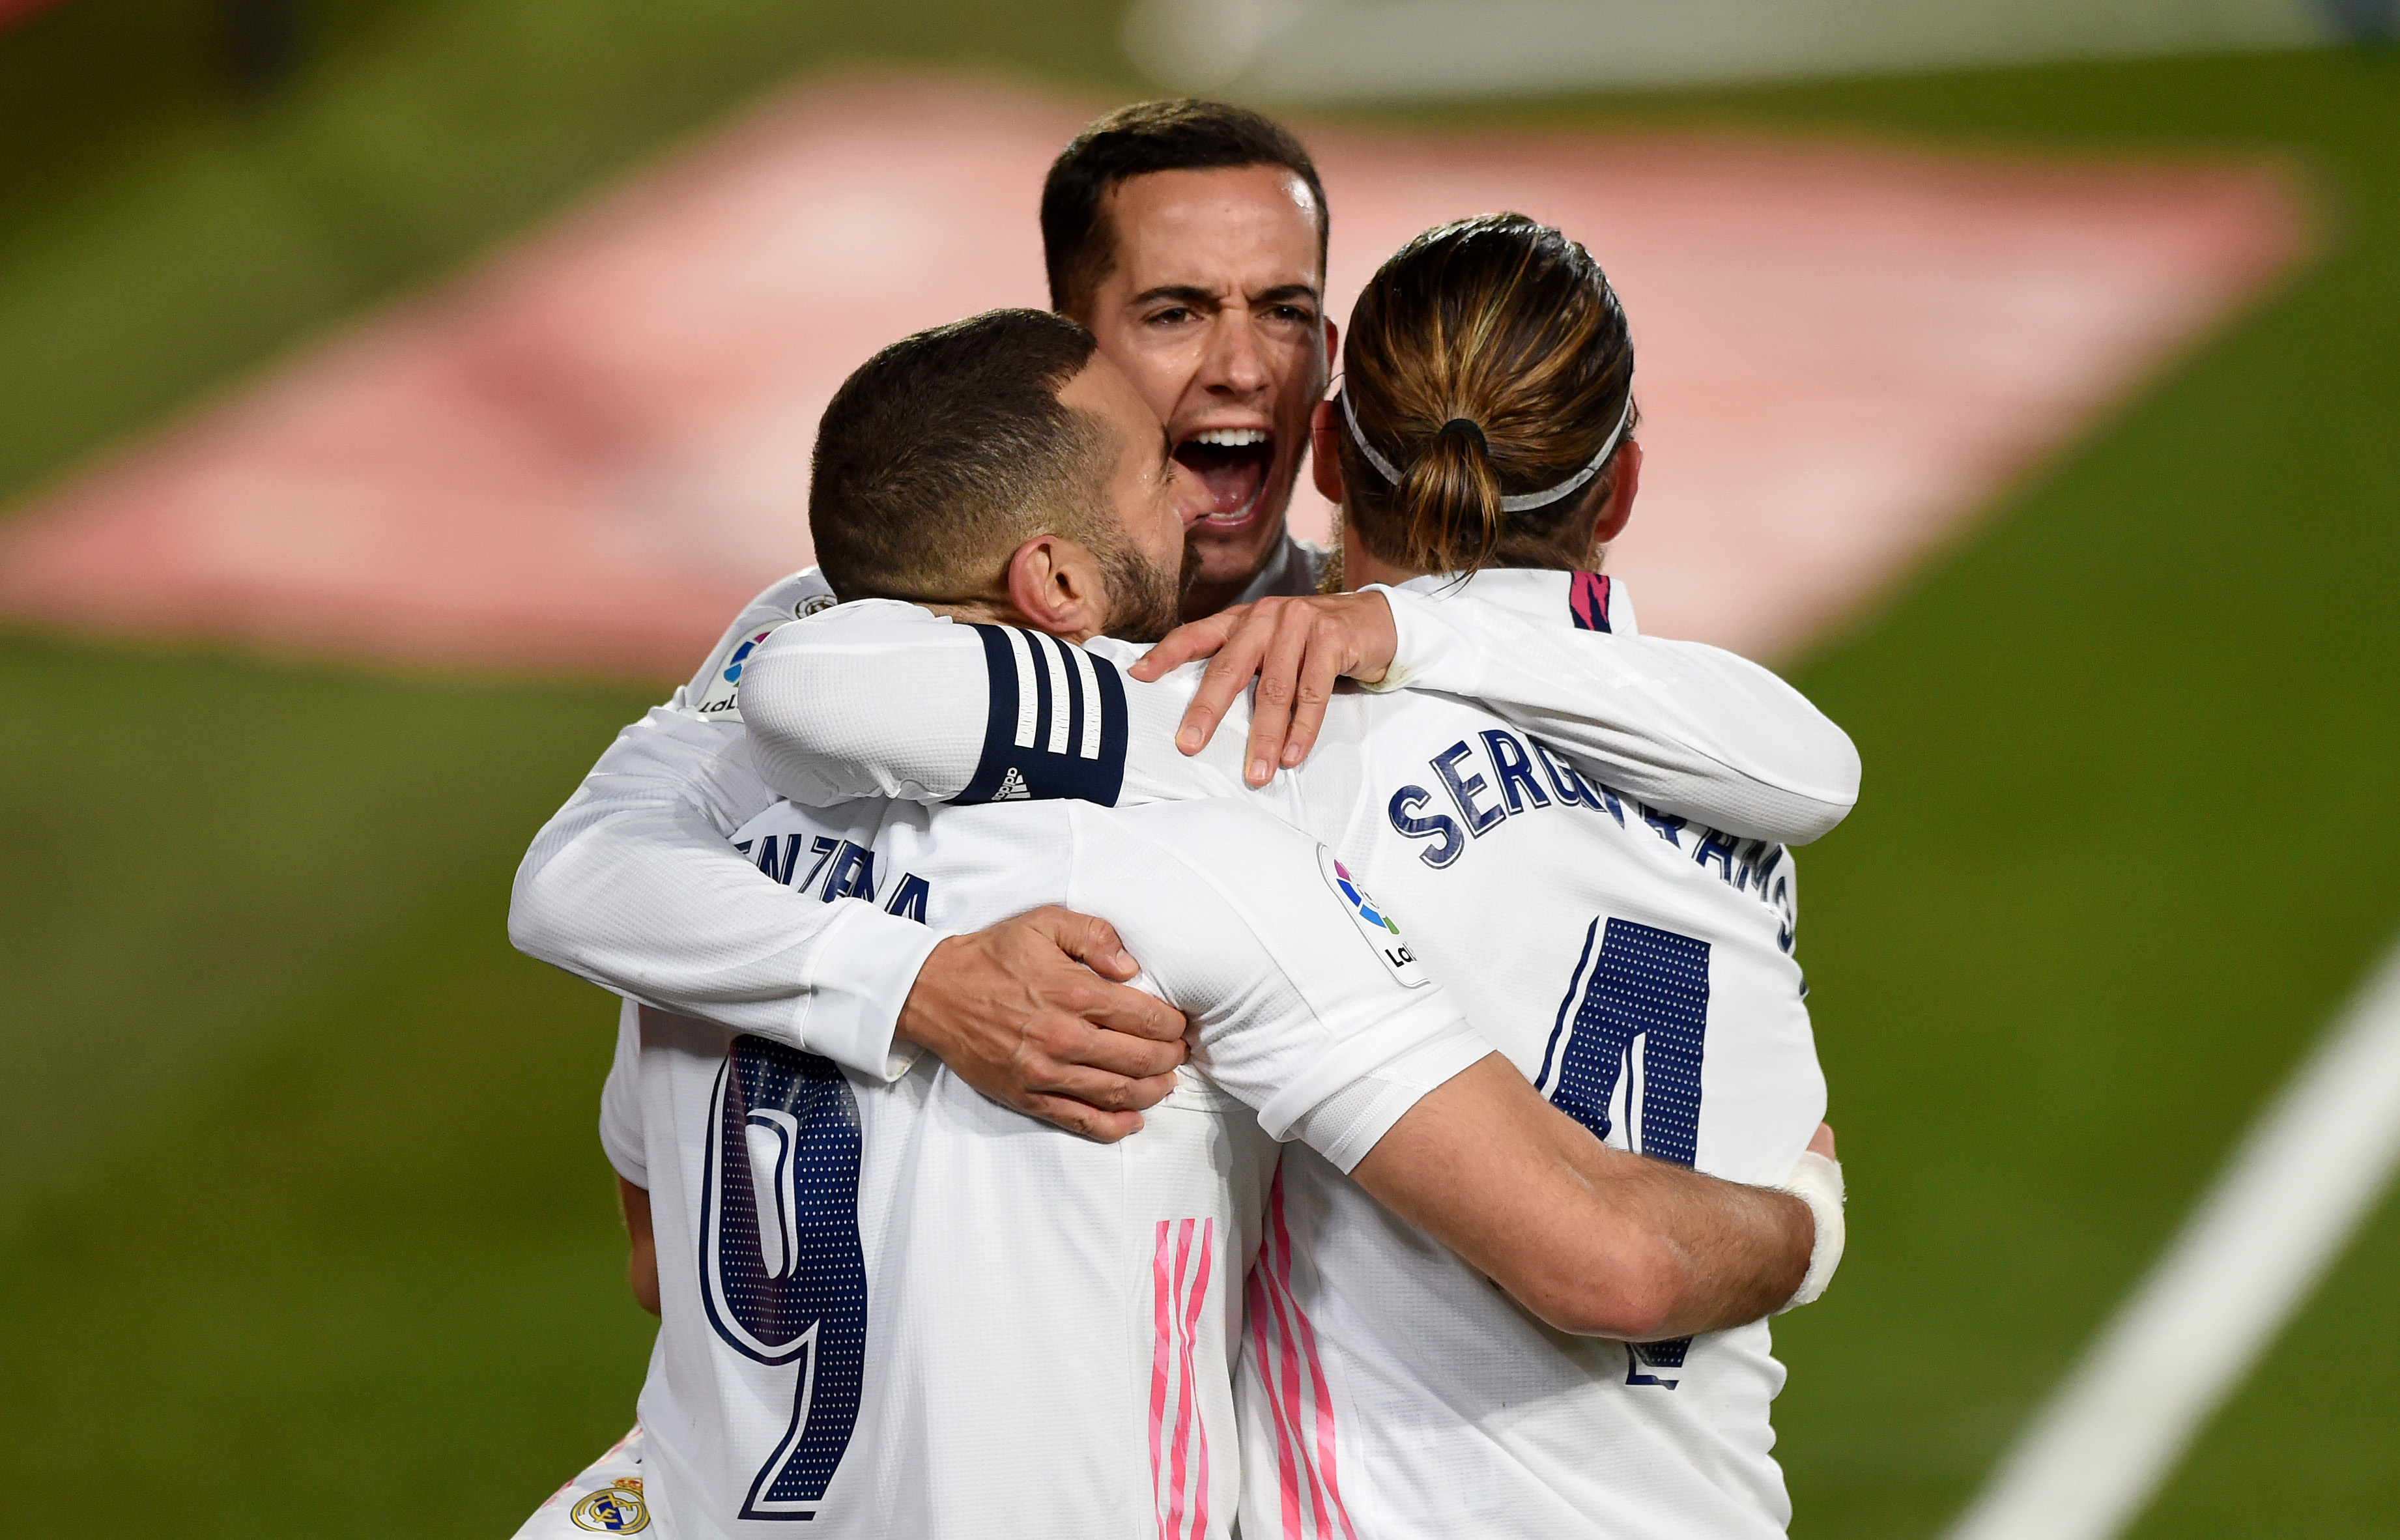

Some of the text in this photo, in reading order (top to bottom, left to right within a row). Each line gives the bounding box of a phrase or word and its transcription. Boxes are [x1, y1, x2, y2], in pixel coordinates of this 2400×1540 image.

[991, 767, 1018, 801] adidas
[699, 1033, 868, 1521] 9
[1534, 915, 1711, 1390] 4
